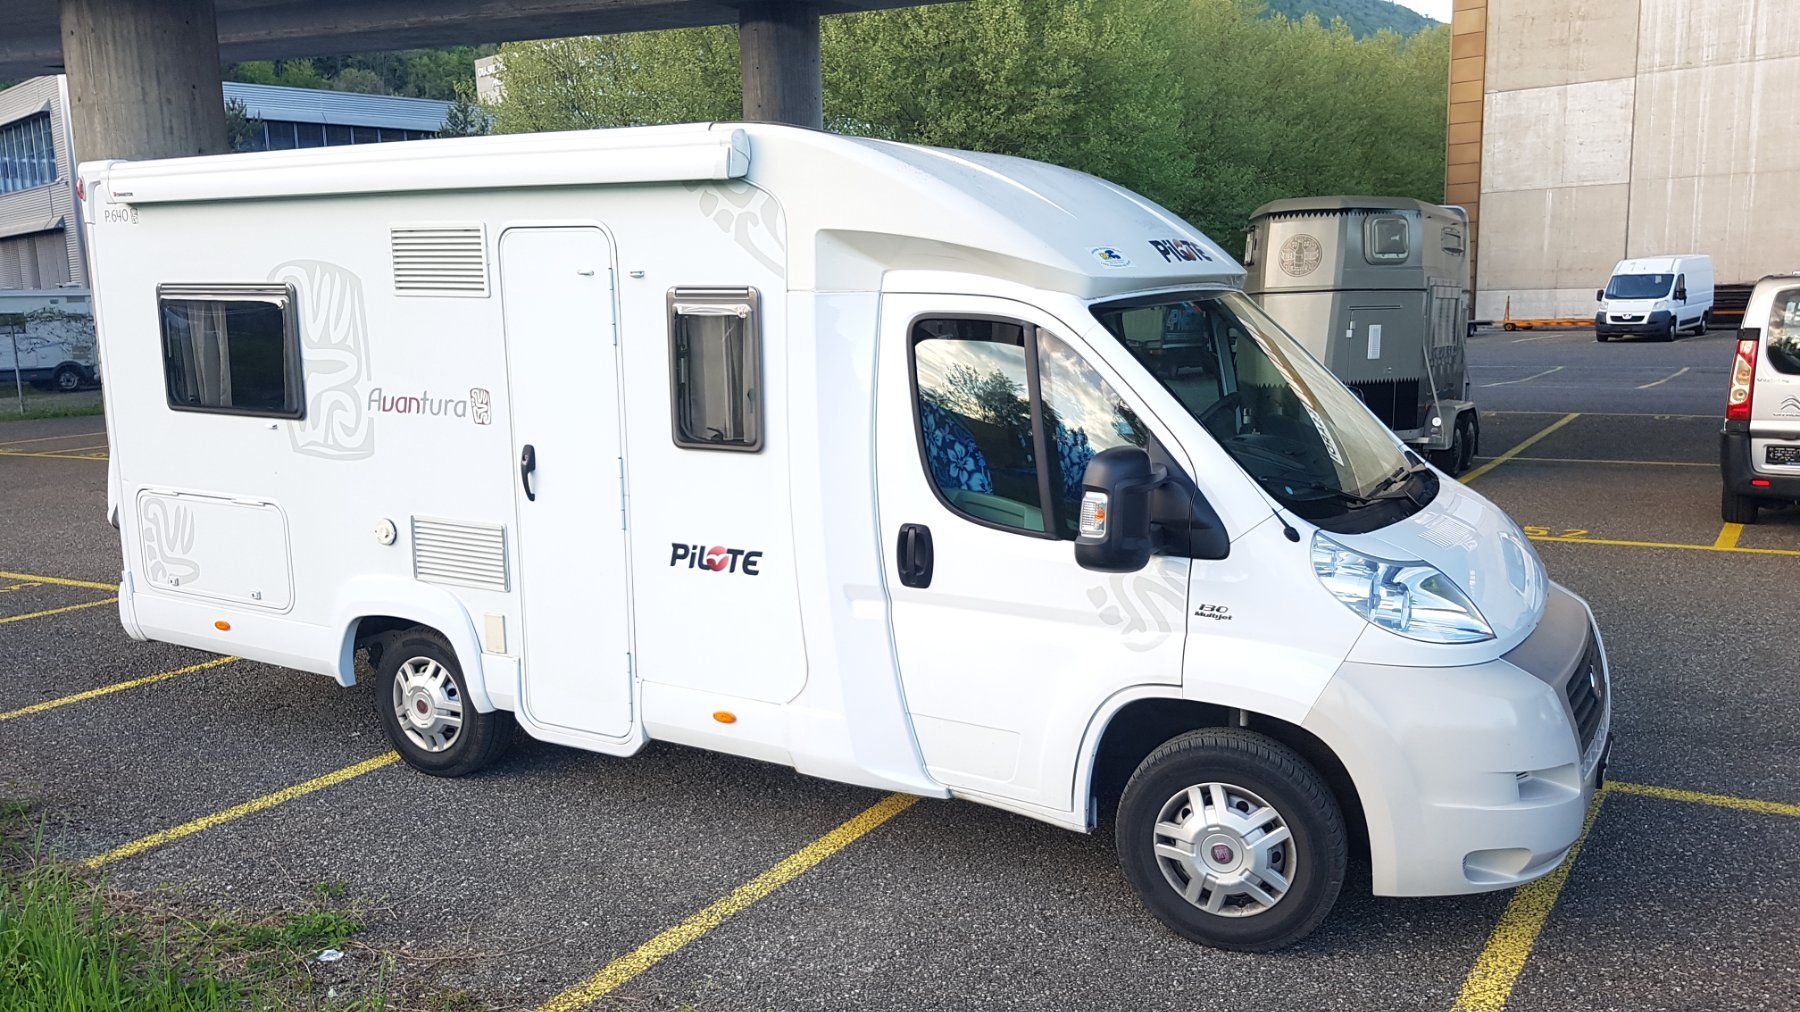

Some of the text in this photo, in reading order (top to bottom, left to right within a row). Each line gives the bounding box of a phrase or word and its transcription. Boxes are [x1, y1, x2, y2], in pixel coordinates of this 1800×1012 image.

[104, 208, 129, 223] P.640
[367, 387, 467, 418] Avantura
[1199, 603, 1229, 614] 130
[1194, 611, 1233, 621] Multijet
